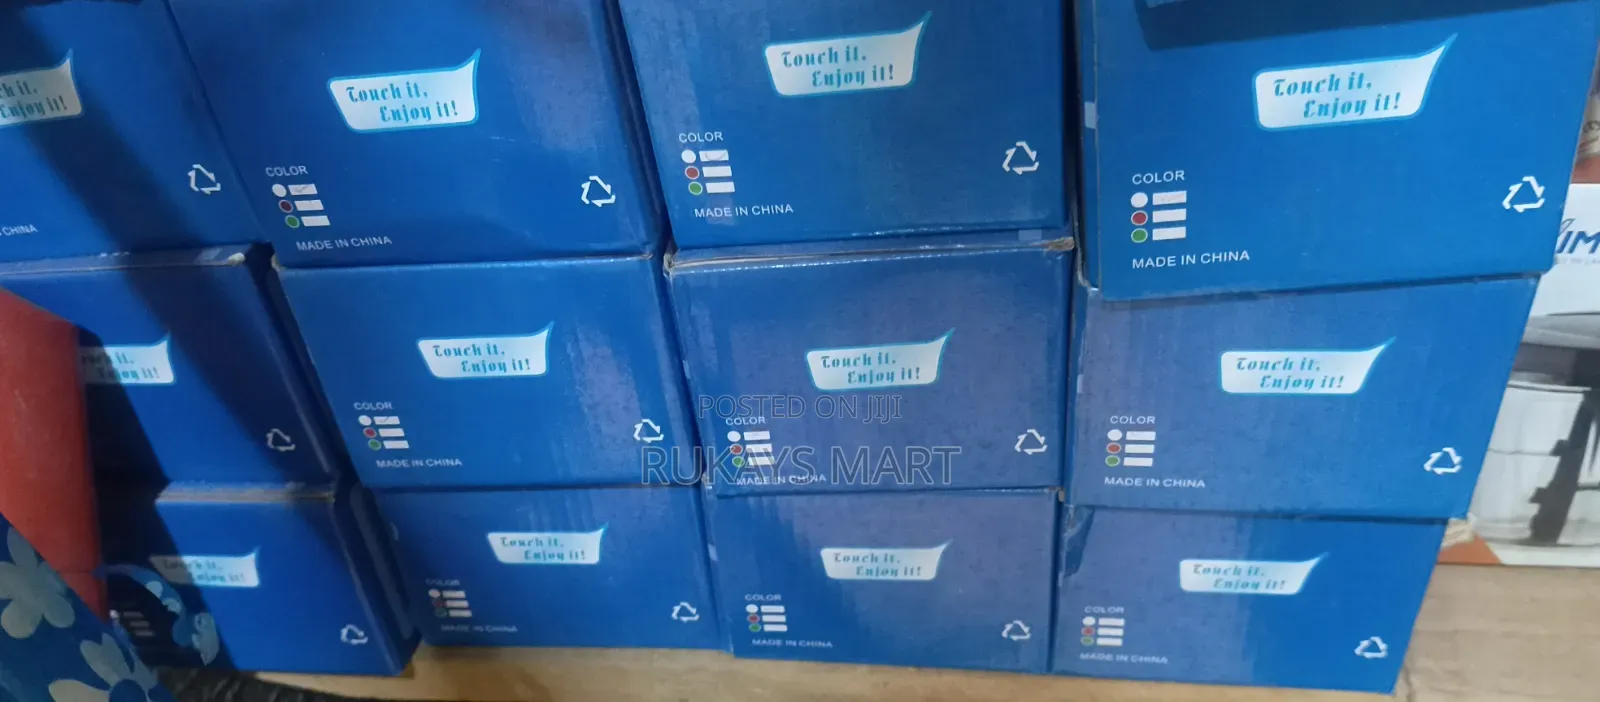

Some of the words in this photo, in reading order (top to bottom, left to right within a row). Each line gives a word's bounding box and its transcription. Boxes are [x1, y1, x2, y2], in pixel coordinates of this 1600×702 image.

[781, 47, 839, 68] Touch
[812, 68, 865, 88] Enjoy
[872, 64, 894, 82] it!
[1273, 74, 1341, 97] Touch
[1347, 71, 1372, 90] it,
[346, 83, 401, 103] Touch
[405, 81, 428, 99] it,
[379, 103, 431, 123] Enjoy
[436, 100, 458, 117] it!
[1303, 98, 1367, 119] Enjoy
[1374, 92, 1401, 111] it!
[679, 131, 723, 143] COLOR
[265, 165, 308, 177] COLOR
[1132, 170, 1185, 185] COLOR
[694, 207, 733, 218] MADE
[735, 206, 748, 216] IN
[751, 204, 794, 216] CHINA
[2, 223, 39, 236] CHINA
[296, 240, 333, 251] MADE
[335, 238, 349, 249] IN
[350, 235, 393, 247] CHINA
[1132, 256, 1176, 269] MADE
[1181, 254, 1196, 265] IN
[1200, 250, 1250, 264] CHINA
[432, 343, 482, 357] Touch
[461, 359, 507, 374] Enjoy
[511, 358, 531, 371] it!
[821, 353, 872, 369] Touch
[1236, 357, 1293, 371] Touch
[847, 369, 895, 385] Enjoy
[900, 367, 920, 380] it!
[1260, 375, 1315, 390] Enjoy
[1321, 374, 1344, 388] it!
[354, 401, 394, 411] COLOR
[725, 416, 766, 426] COLOR
[1110, 415, 1156, 425] COLOR
[376, 459, 409, 468] MADE
[411, 459, 424, 467] IN
[425, 459, 462, 467] CHINA
[771, 475, 786, 485] IN
[788, 474, 827, 485] CHINA
[1104, 476, 1142, 486] MADE
[1146, 478, 1159, 487] IN
[1162, 478, 1206, 488] CHINA
[500, 537, 544, 548] Touch
[524, 550, 564, 561] Enjoy
[833, 552, 879, 564] Touch
[856, 565, 899, 577] Enjoy
[903, 565, 922, 576] it!
[1193, 563, 1241, 575] Touch
[1213, 578, 1260, 590] Enjoy
[744, 593, 782, 601] COLOR
[1084, 606, 1125, 614] COLOR
[752, 638, 783, 646] MADE
[798, 640, 833, 648] CHINA
